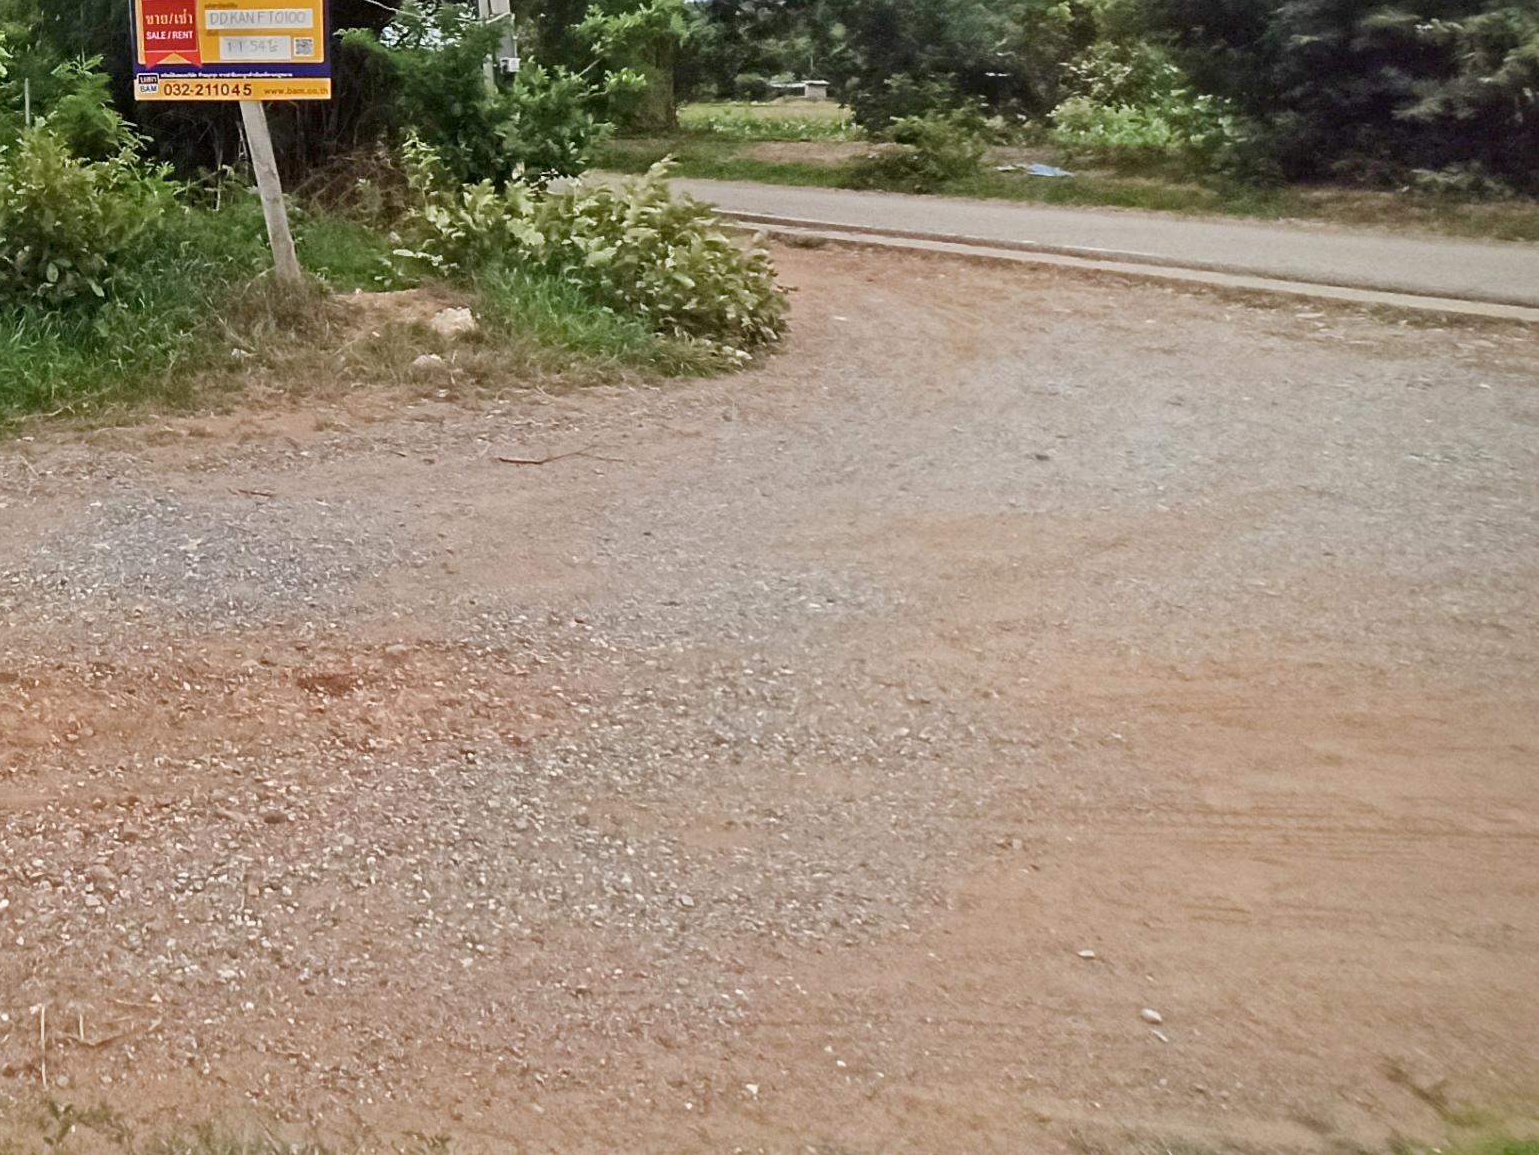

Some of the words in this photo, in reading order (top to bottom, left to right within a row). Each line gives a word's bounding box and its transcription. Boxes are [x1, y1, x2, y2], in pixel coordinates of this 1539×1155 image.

[145, 8, 193, 25] ขาย/เช่า
[140, 85, 157, 93] BAM
[164, 83, 252, 96] 032-211045
